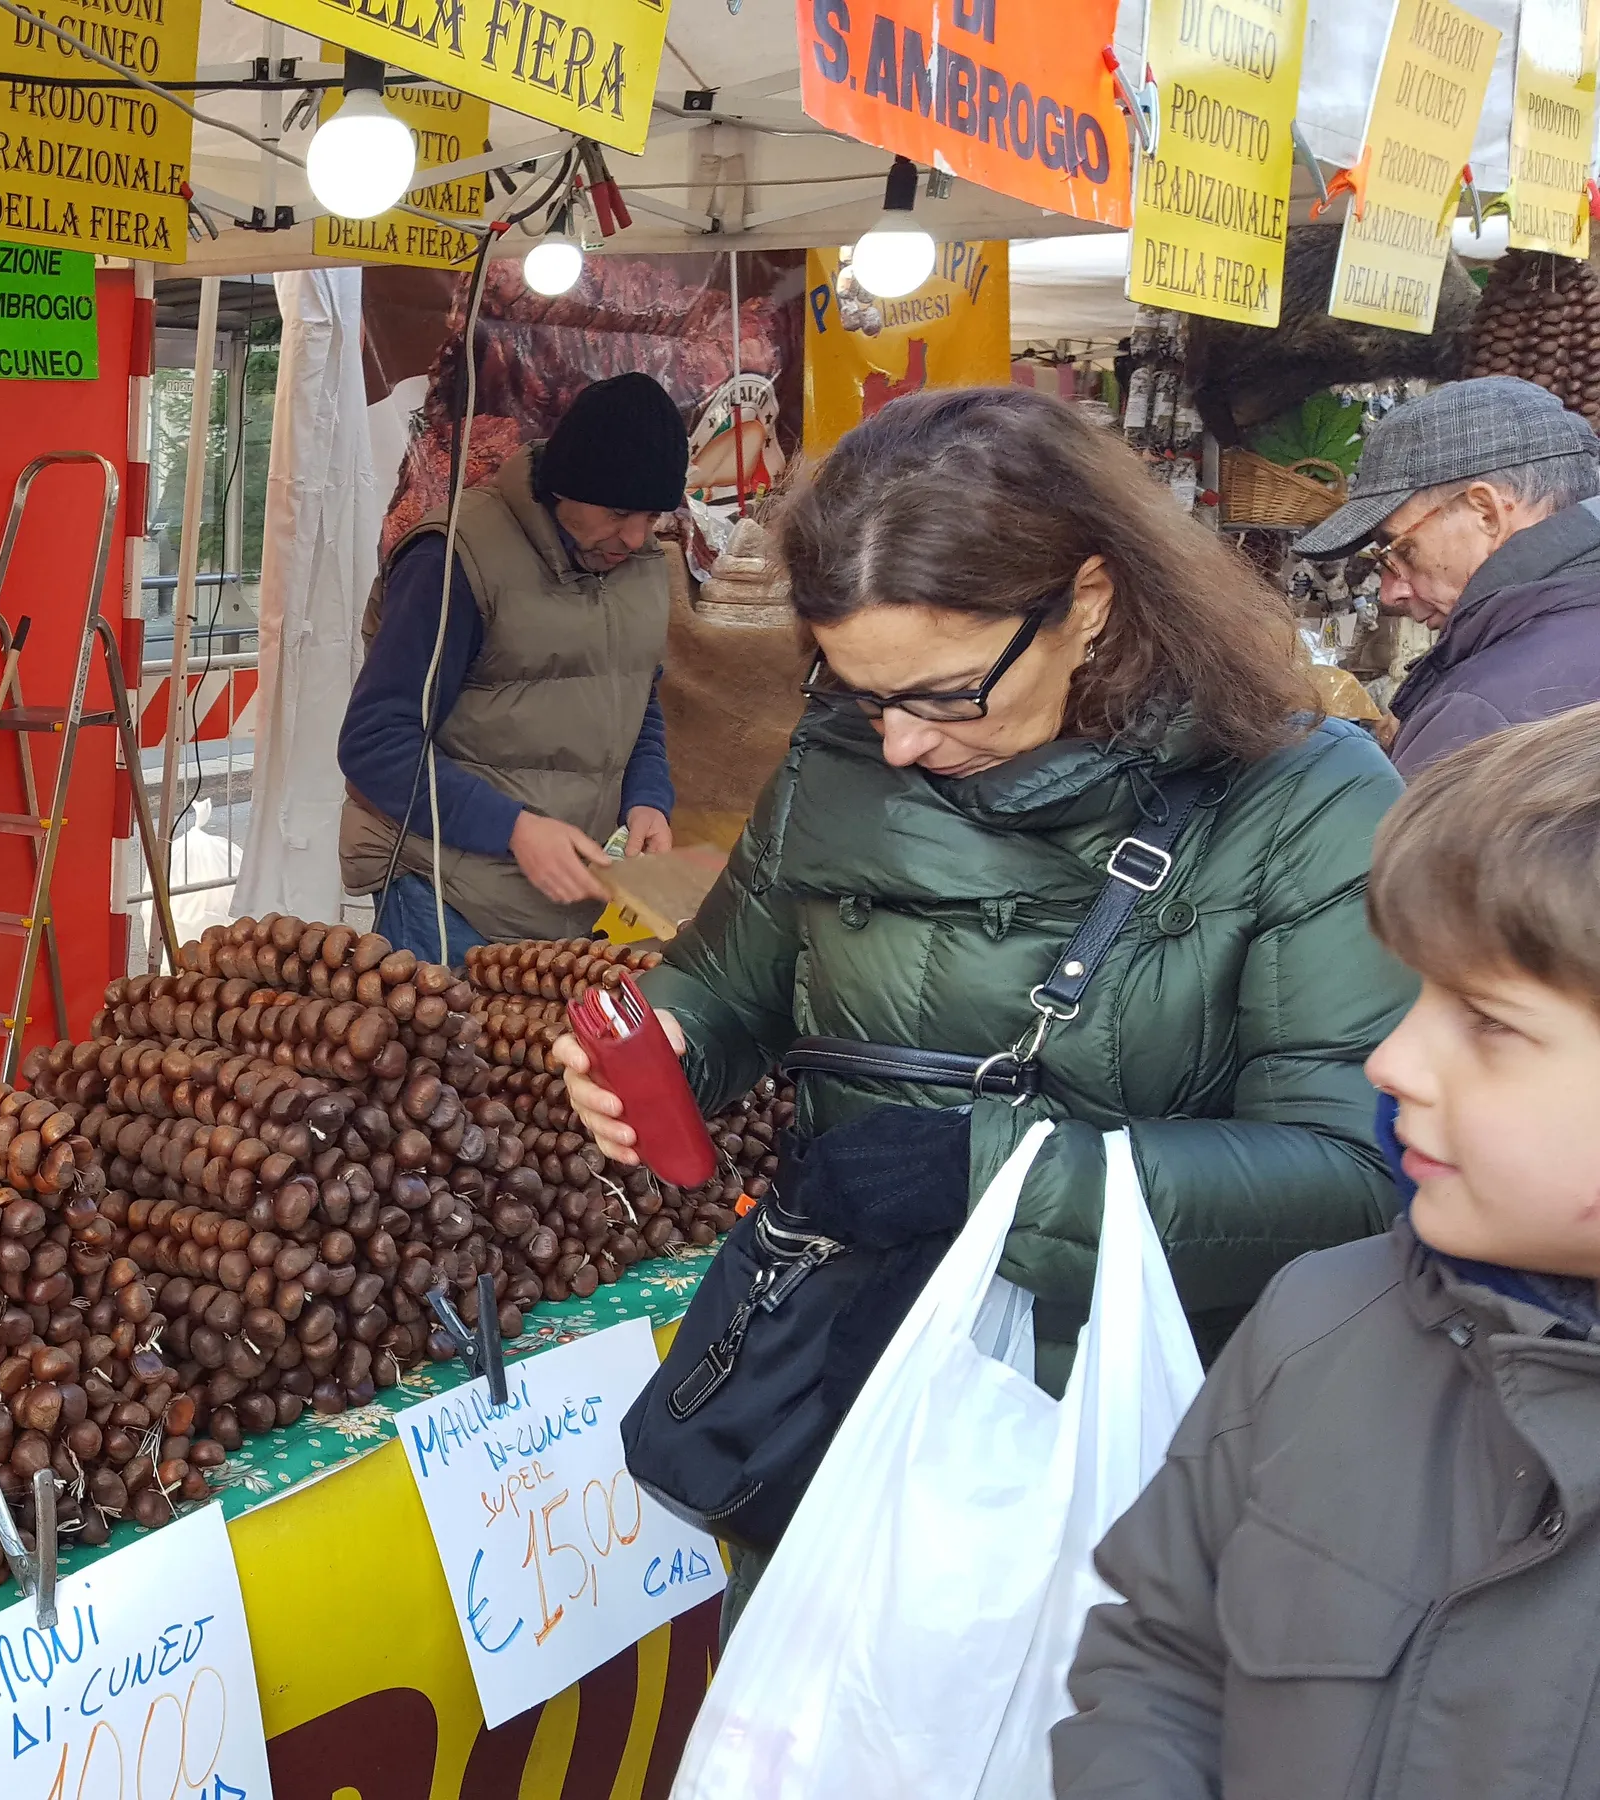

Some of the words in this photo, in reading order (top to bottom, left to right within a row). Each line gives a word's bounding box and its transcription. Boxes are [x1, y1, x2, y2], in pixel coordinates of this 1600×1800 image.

[13, 4, 48, 53] DI
[56, 15, 161, 76] CUNEO
[481, 0, 628, 122] FIERA
[1208, 4, 1276, 84] CUNEO
[8, 81, 159, 138] PRODOTTO
[1169, 82, 1270, 164] PRODOTTO
[1395, 60, 1418, 109] DI
[1415, 69, 1467, 131] CUNEO
[1527, 91, 1581, 141] PRODOTTO
[1142, 155, 1285, 243] TRADIZIONALE
[1378, 136, 1450, 197] PRODOTTO
[89, 205, 173, 252] FIERA
[328, 215, 400, 254] DELLA
[407, 225, 468, 260] FIERA
[1142, 237, 1207, 299] DELLA
[1212, 256, 1270, 313] FIERA
[1343, 264, 1391, 311] DELLA
[1391, 275, 1433, 319] FIERA
[480, 1460, 555, 1528] SUPER
[643, 1546, 712, 1598] CAD
